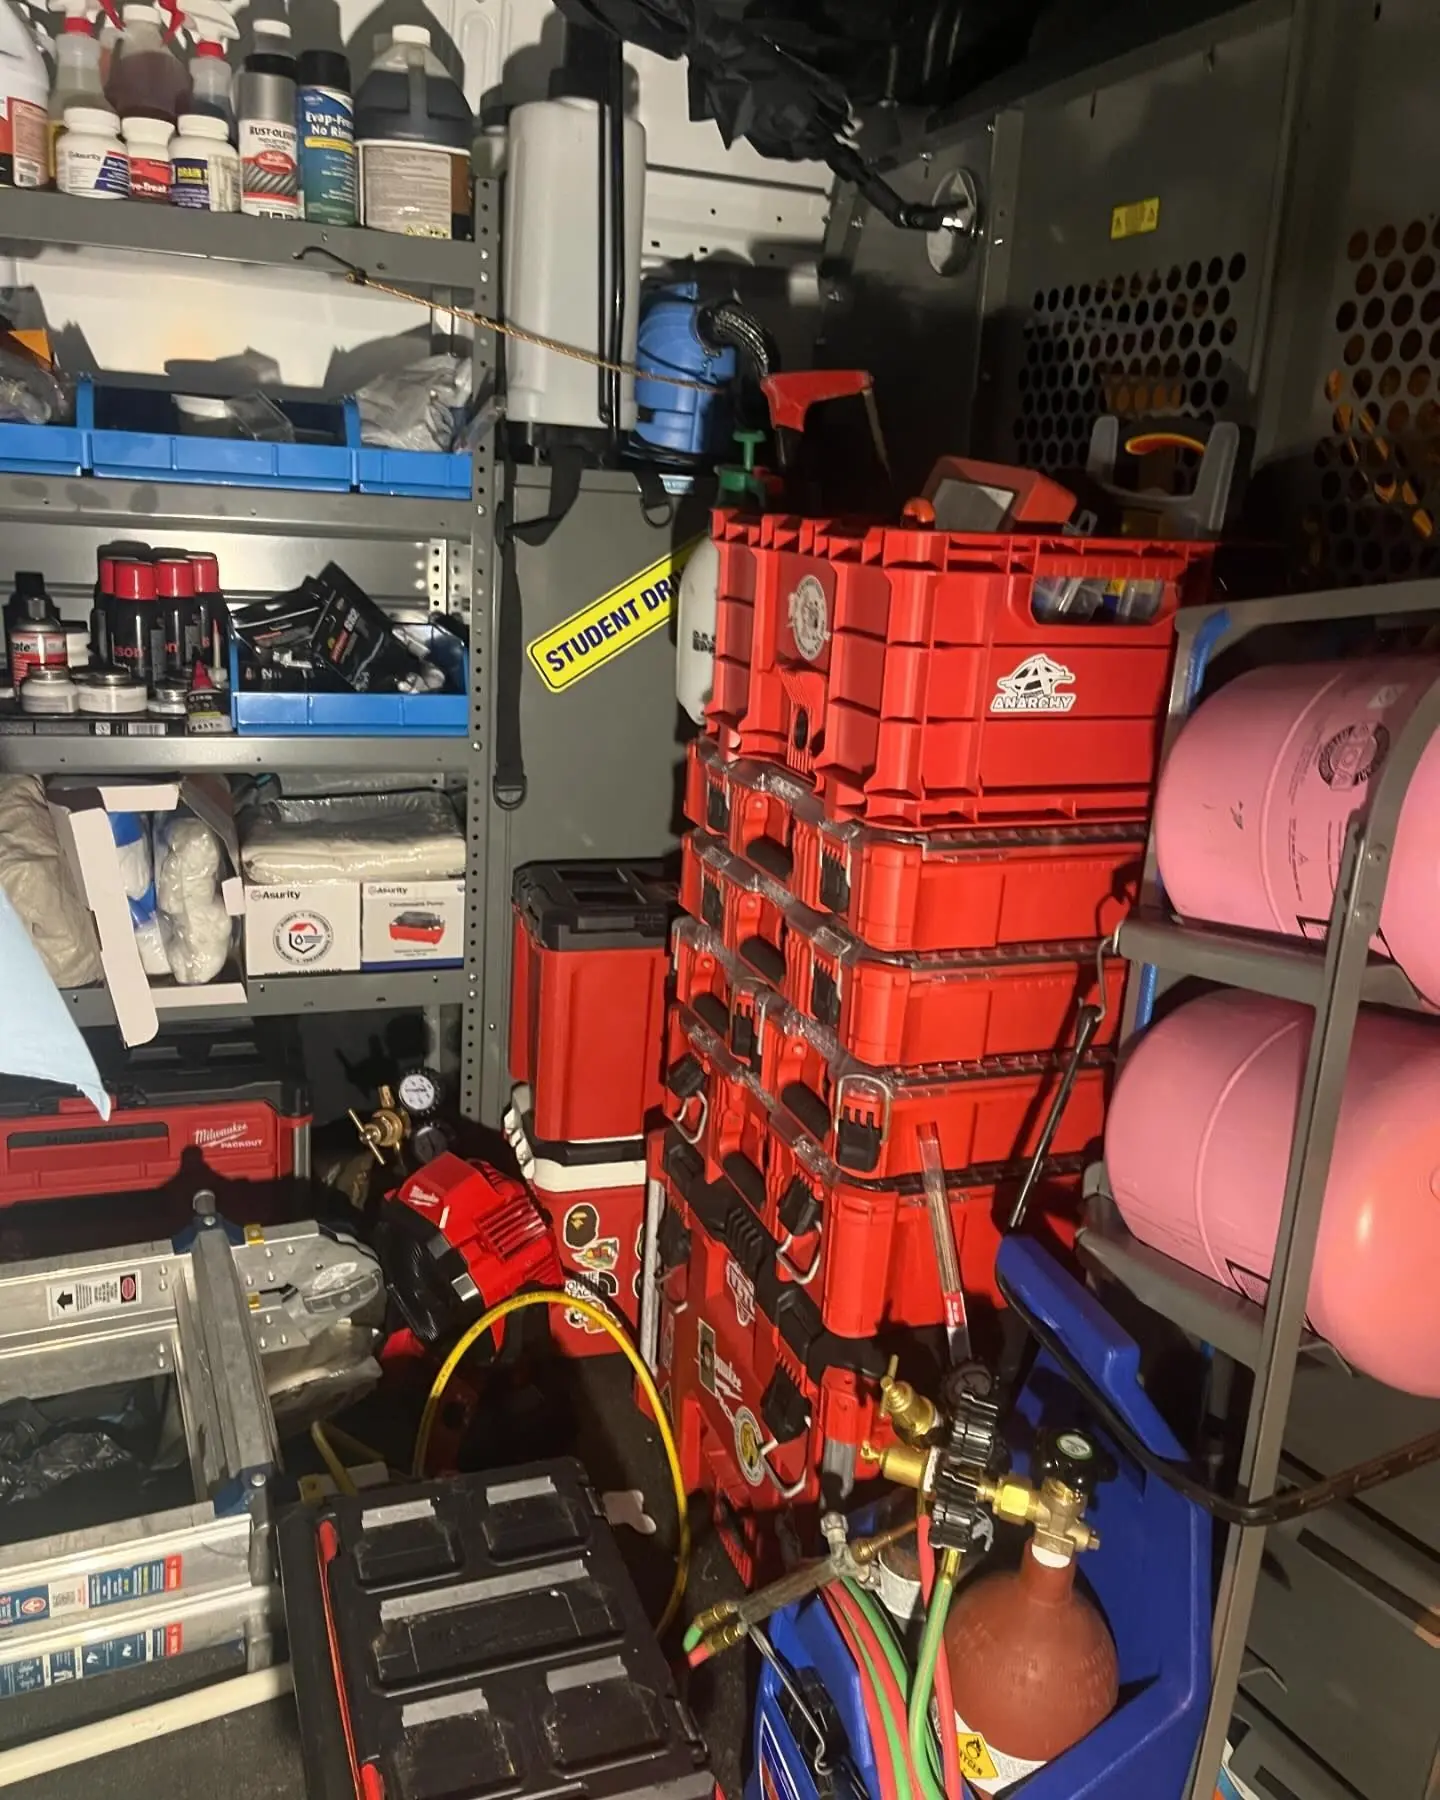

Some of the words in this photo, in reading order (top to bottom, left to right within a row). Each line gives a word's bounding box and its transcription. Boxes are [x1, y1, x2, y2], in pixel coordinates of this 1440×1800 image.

[311, 124, 328, 136] No
[545, 597, 641, 673] STUDENT
[992, 695, 1073, 711] ANARCHY
[262, 889, 301, 901] Asurity
[376, 886, 408, 895] Asurity
[192, 1121, 249, 1145] Milwaukee
[220, 1138, 263, 1149] PACKOUT
